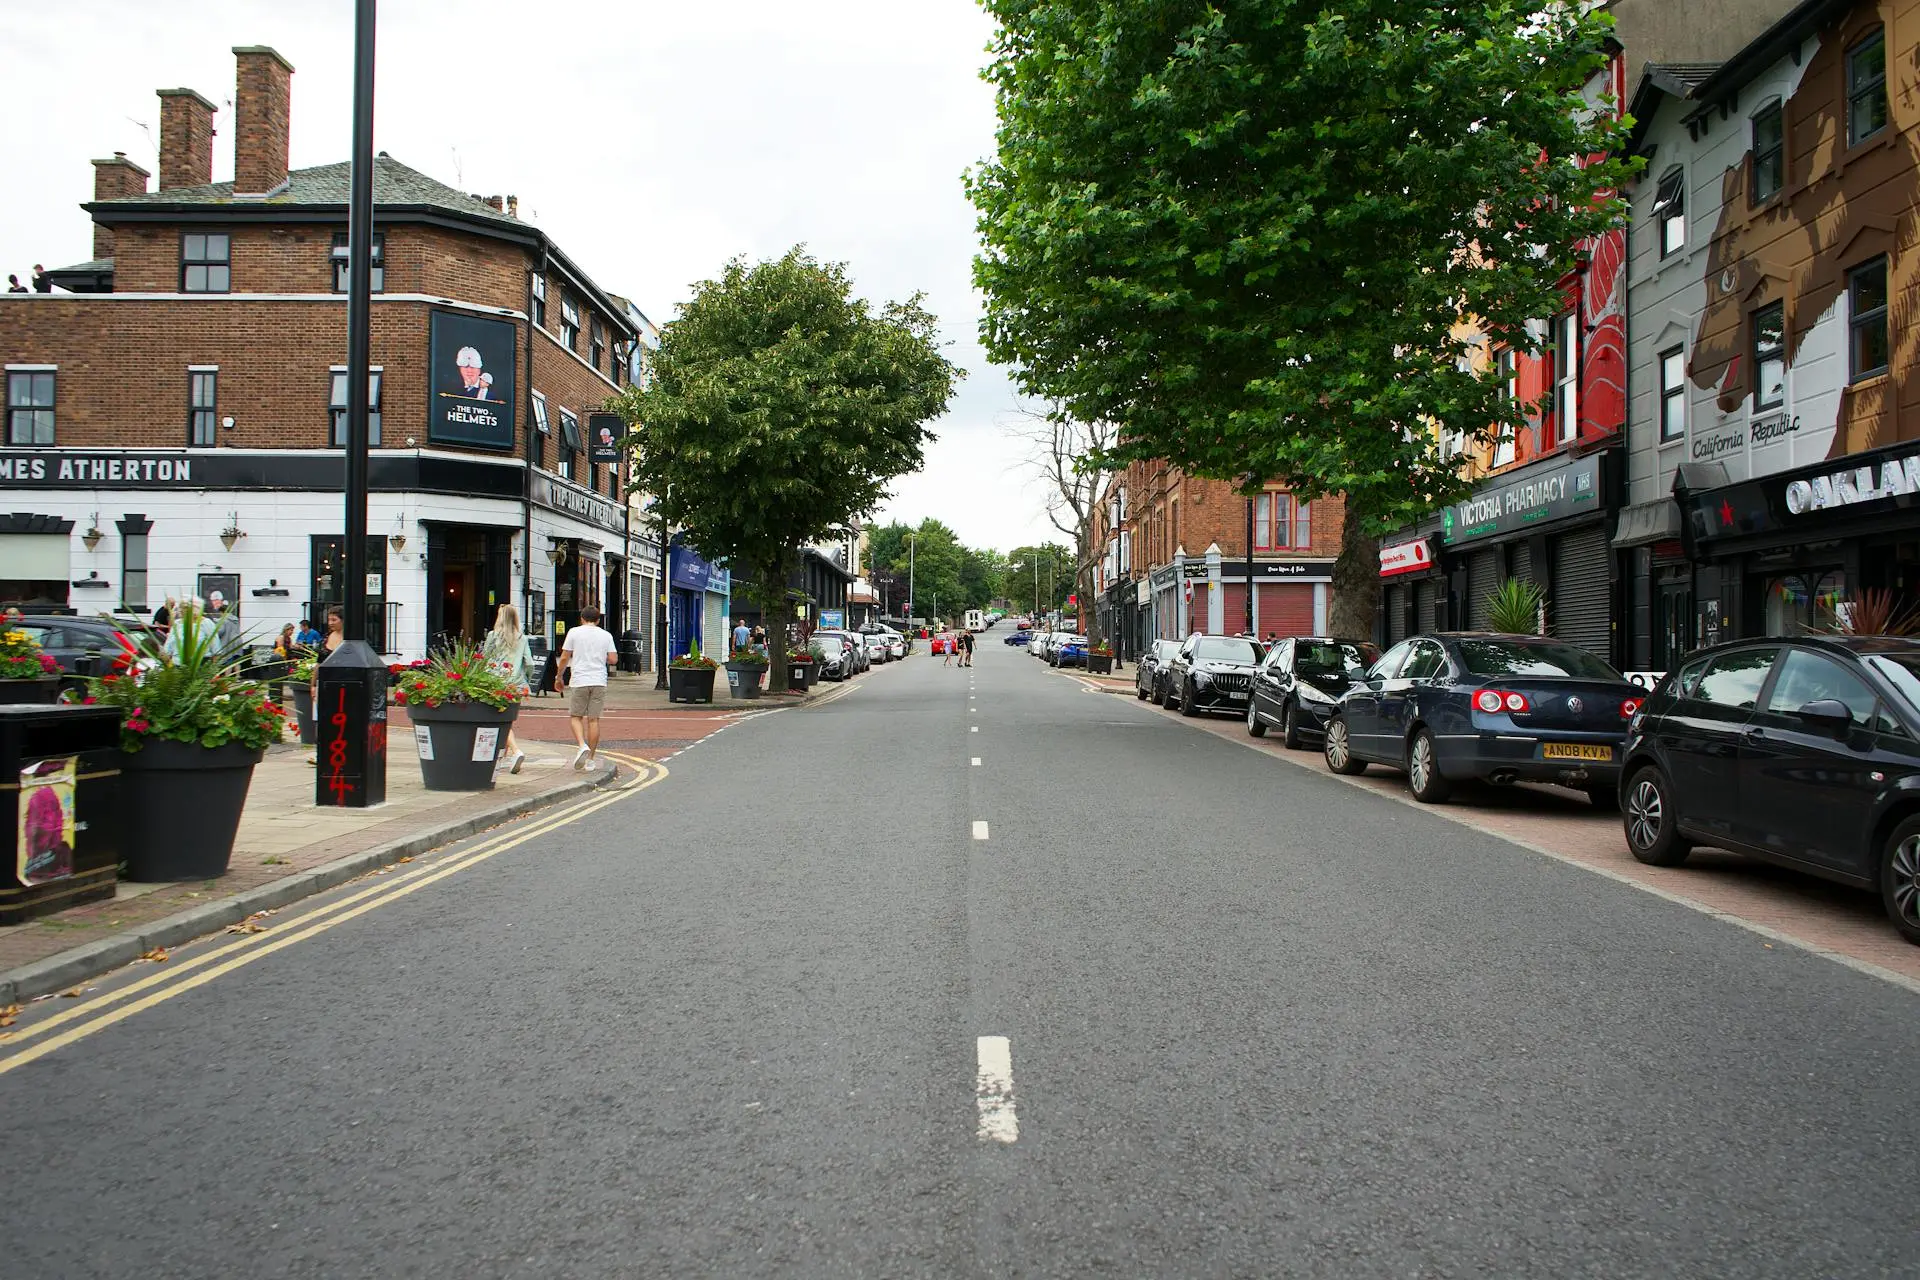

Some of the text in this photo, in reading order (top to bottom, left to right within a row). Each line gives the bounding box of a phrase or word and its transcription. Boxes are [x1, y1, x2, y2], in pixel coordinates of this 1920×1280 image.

[447, 411, 498, 426] HELMETS
[456, 405, 489, 415] THE TWO
[1692, 431, 1743, 460] California
[58, 459, 192, 481] ATHERTON
[1460, 495, 1502, 527] VICTORIA
[1505, 474, 1567, 515] PHARMACY
[1577, 473, 1591, 492] NHS
[1548, 745, 1606, 759] AN08 KVA
